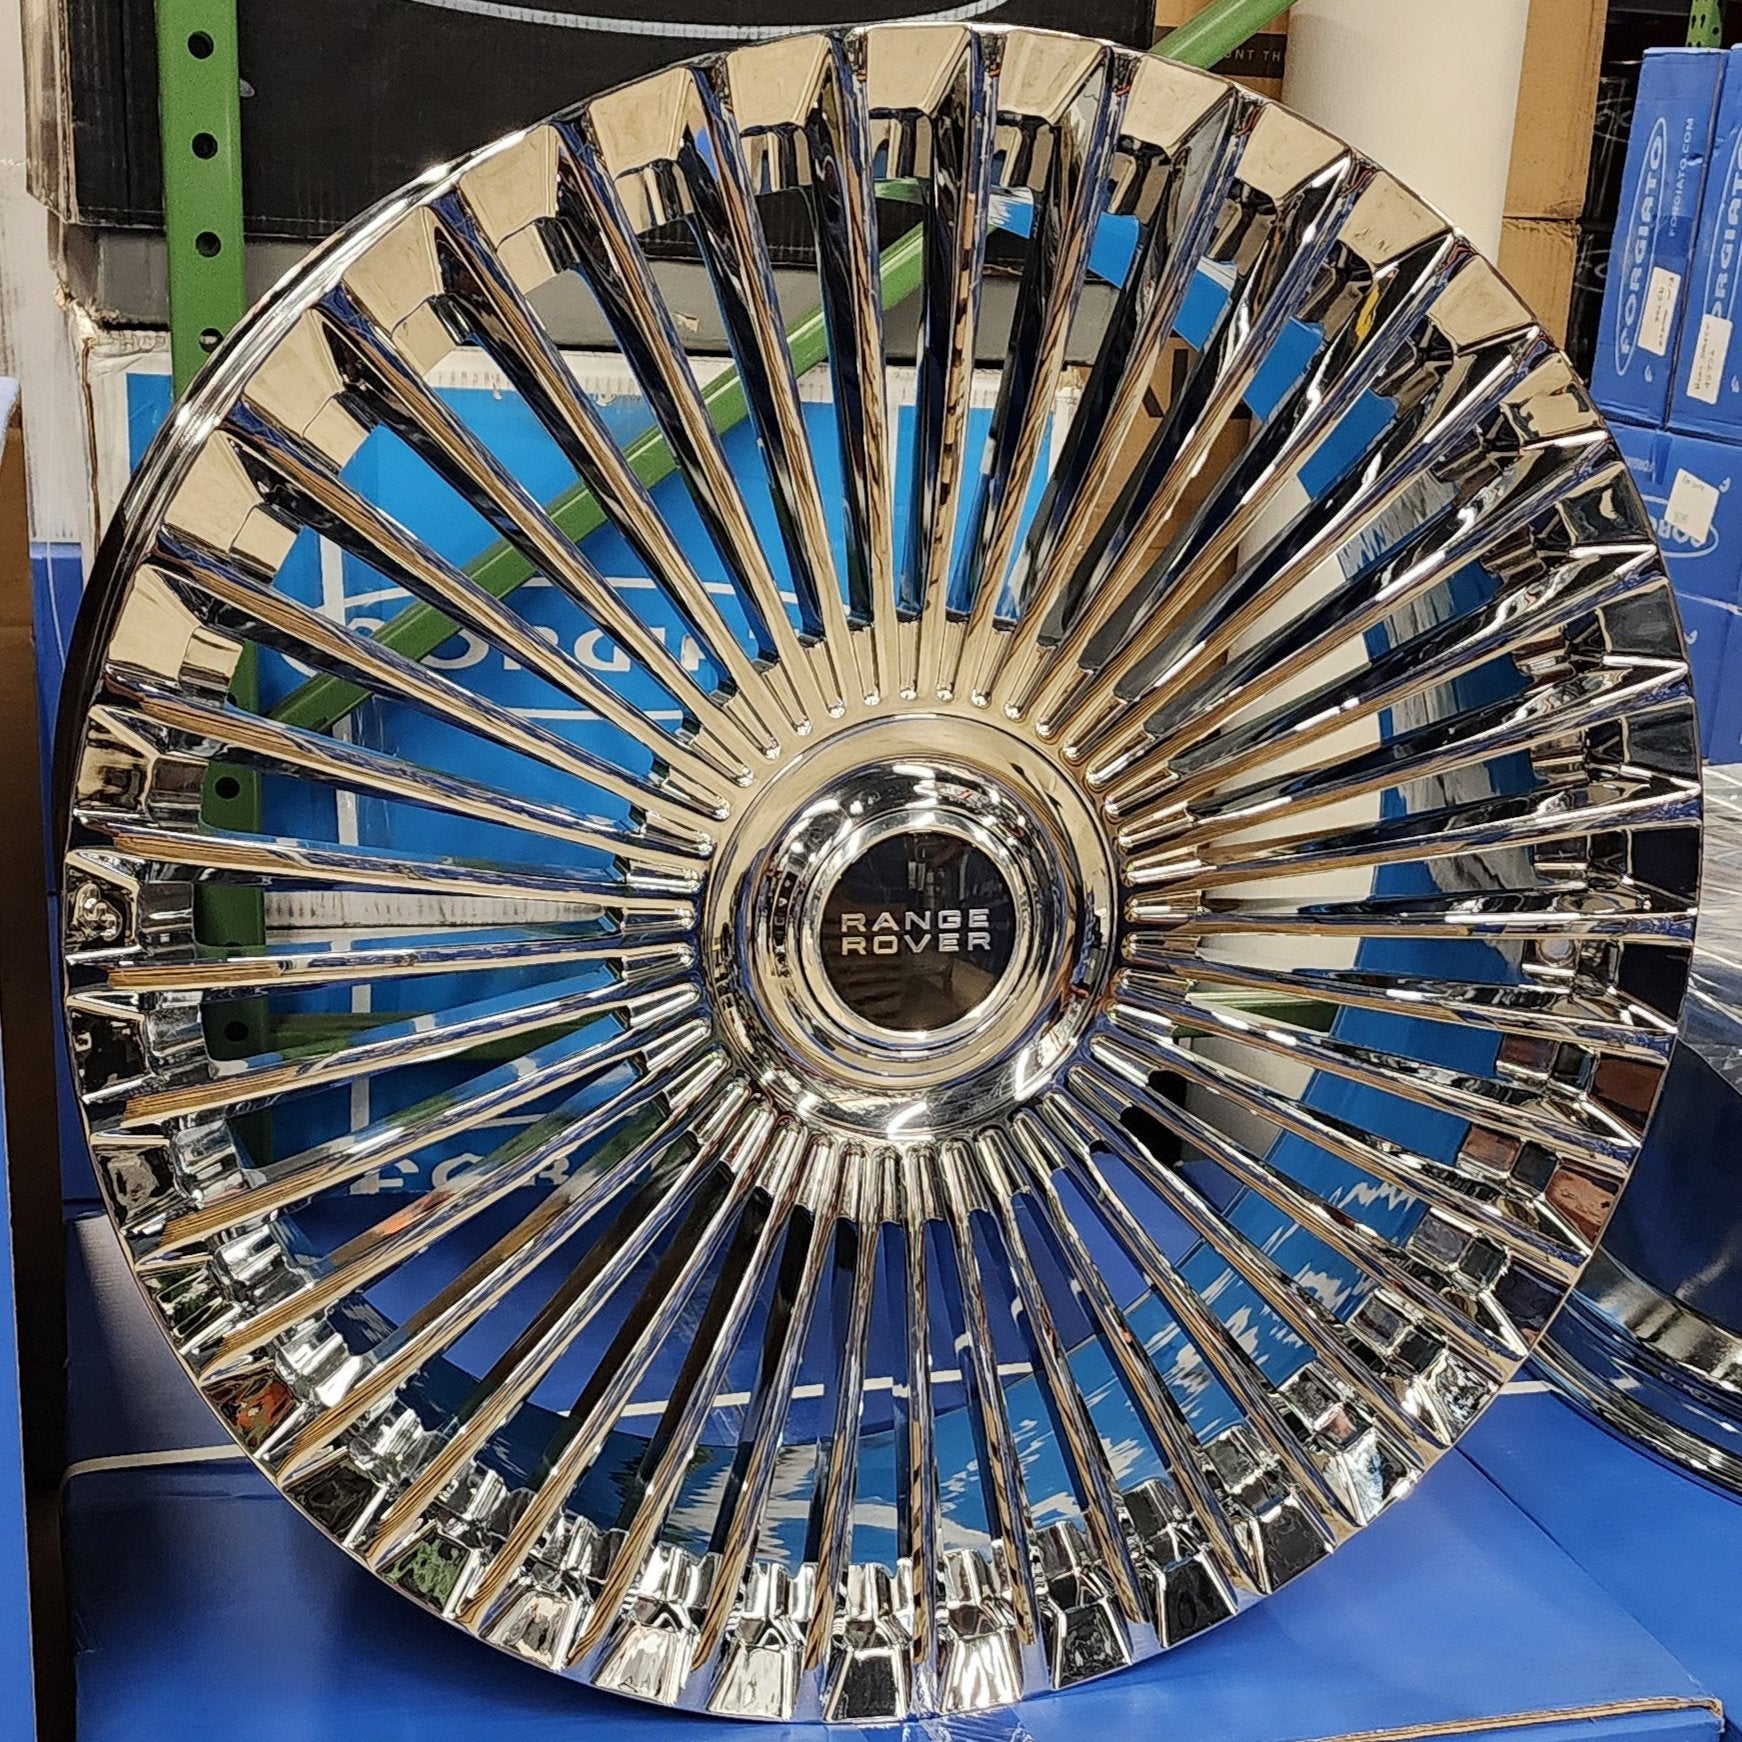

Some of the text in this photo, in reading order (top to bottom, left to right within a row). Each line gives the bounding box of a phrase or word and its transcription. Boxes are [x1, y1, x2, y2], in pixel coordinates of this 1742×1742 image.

[1620, 135, 1662, 355] FORGIATO
[840, 908, 990, 933] RANGE
[841, 931, 992, 956] ROVER
